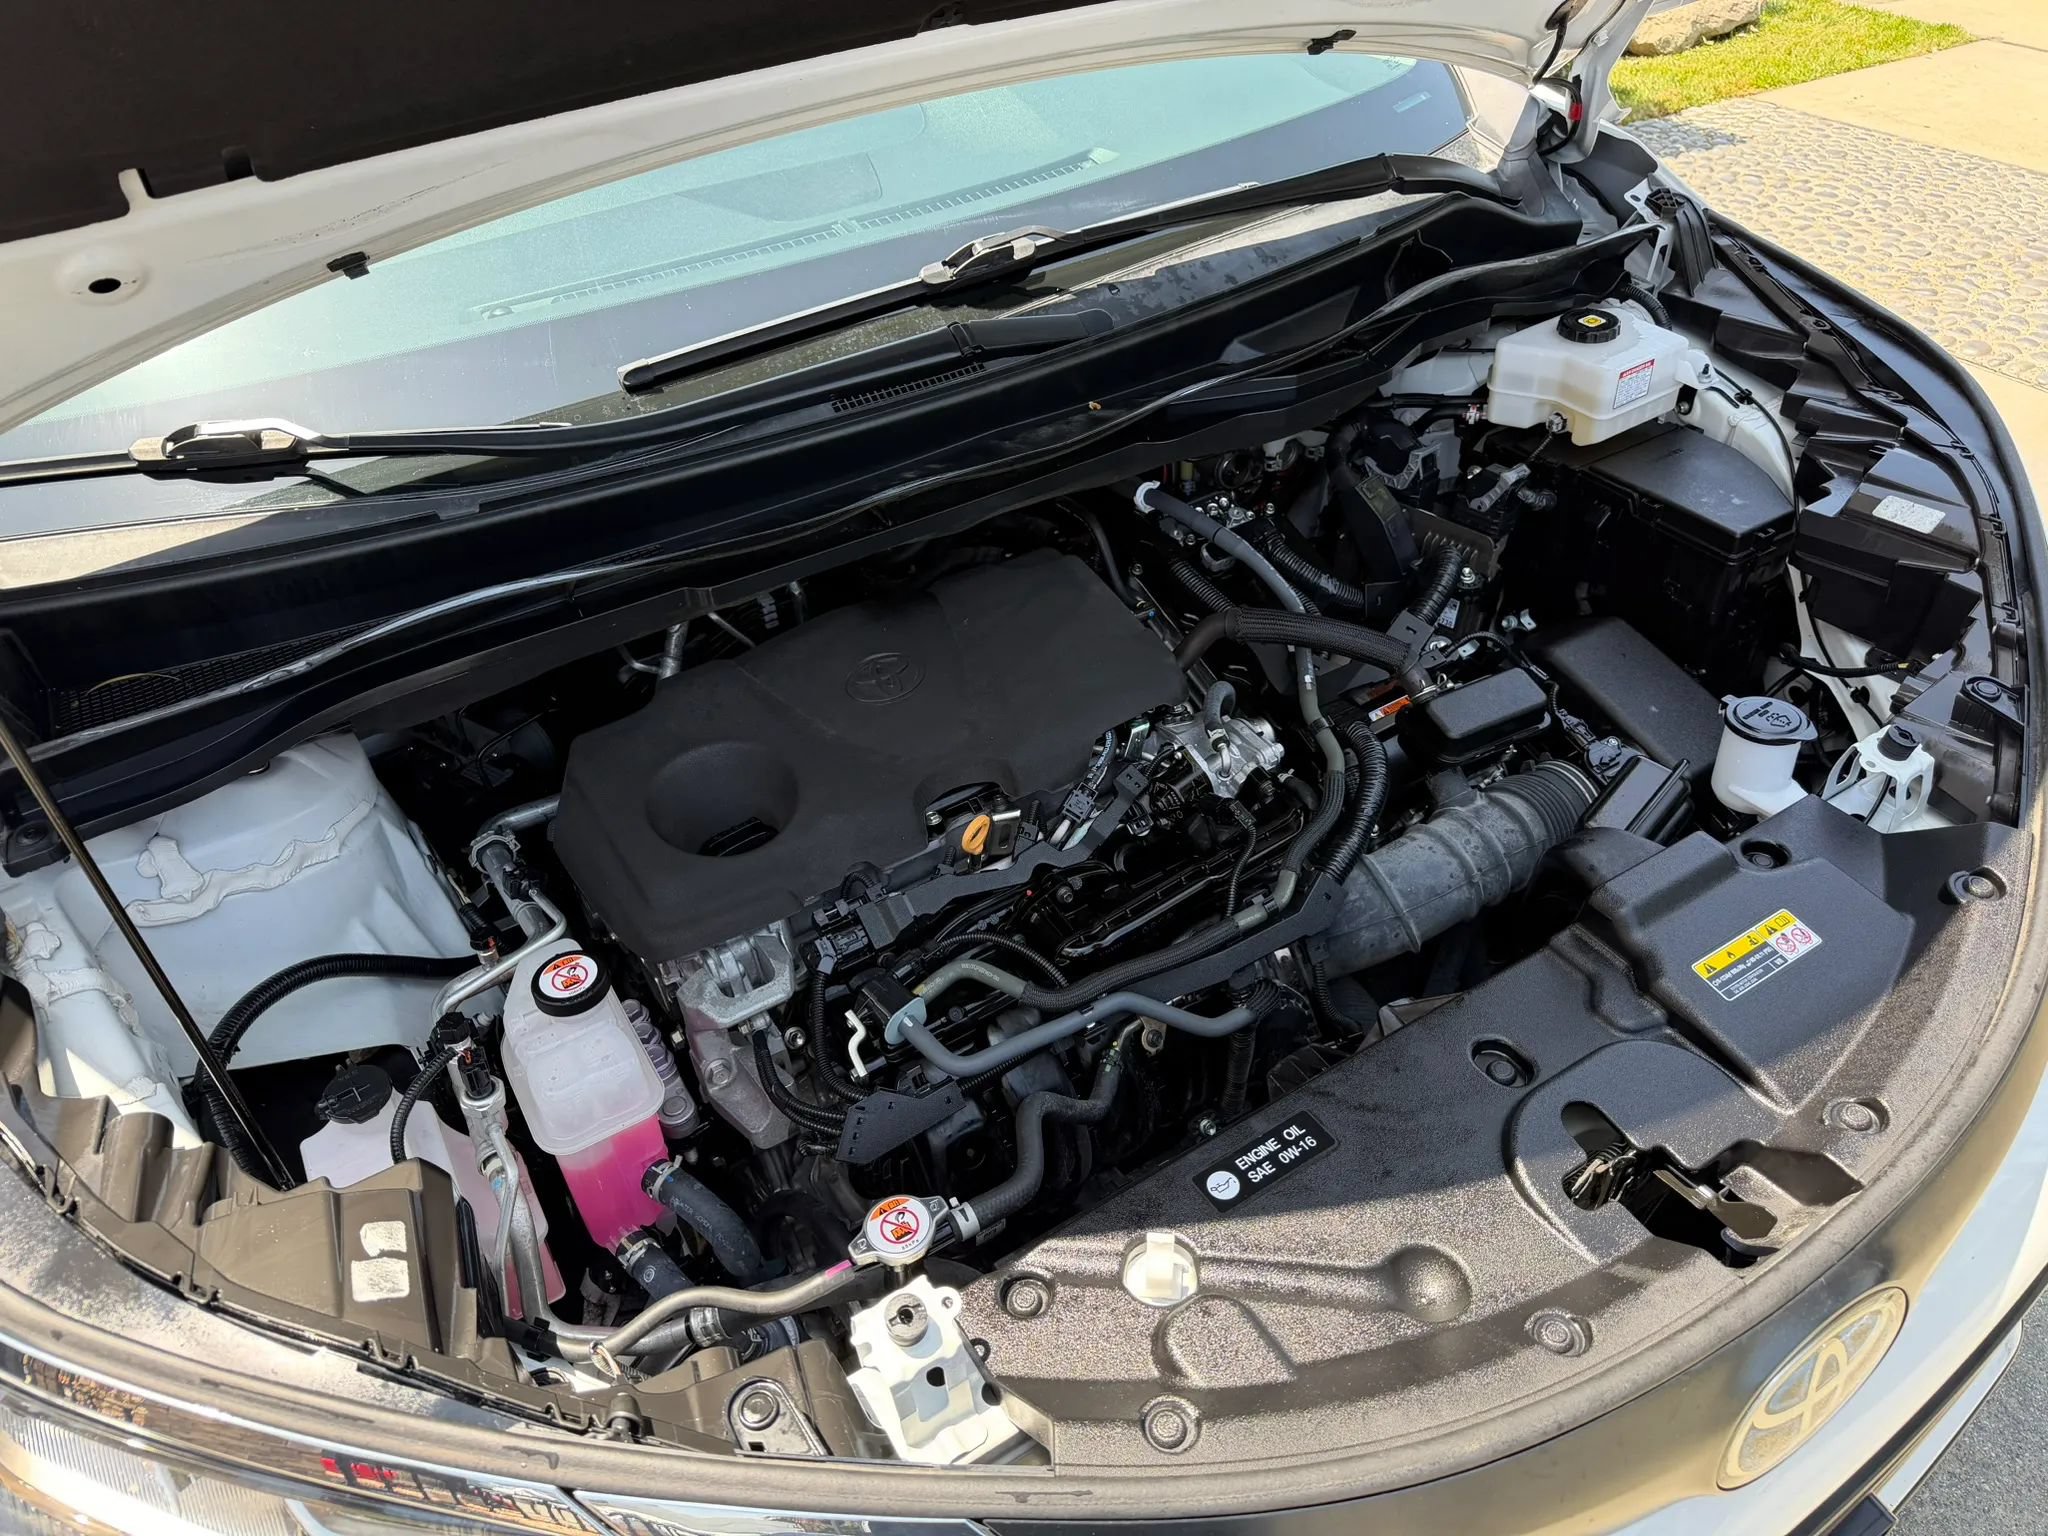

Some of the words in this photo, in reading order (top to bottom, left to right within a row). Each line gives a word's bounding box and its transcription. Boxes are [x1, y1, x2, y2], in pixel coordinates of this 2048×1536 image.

[1234, 1137, 1282, 1170] ENGINE
[1283, 1124, 1306, 1141] OIL
[1247, 1160, 1277, 1183] SAE
[1278, 1135, 1317, 1164] 0W-16
